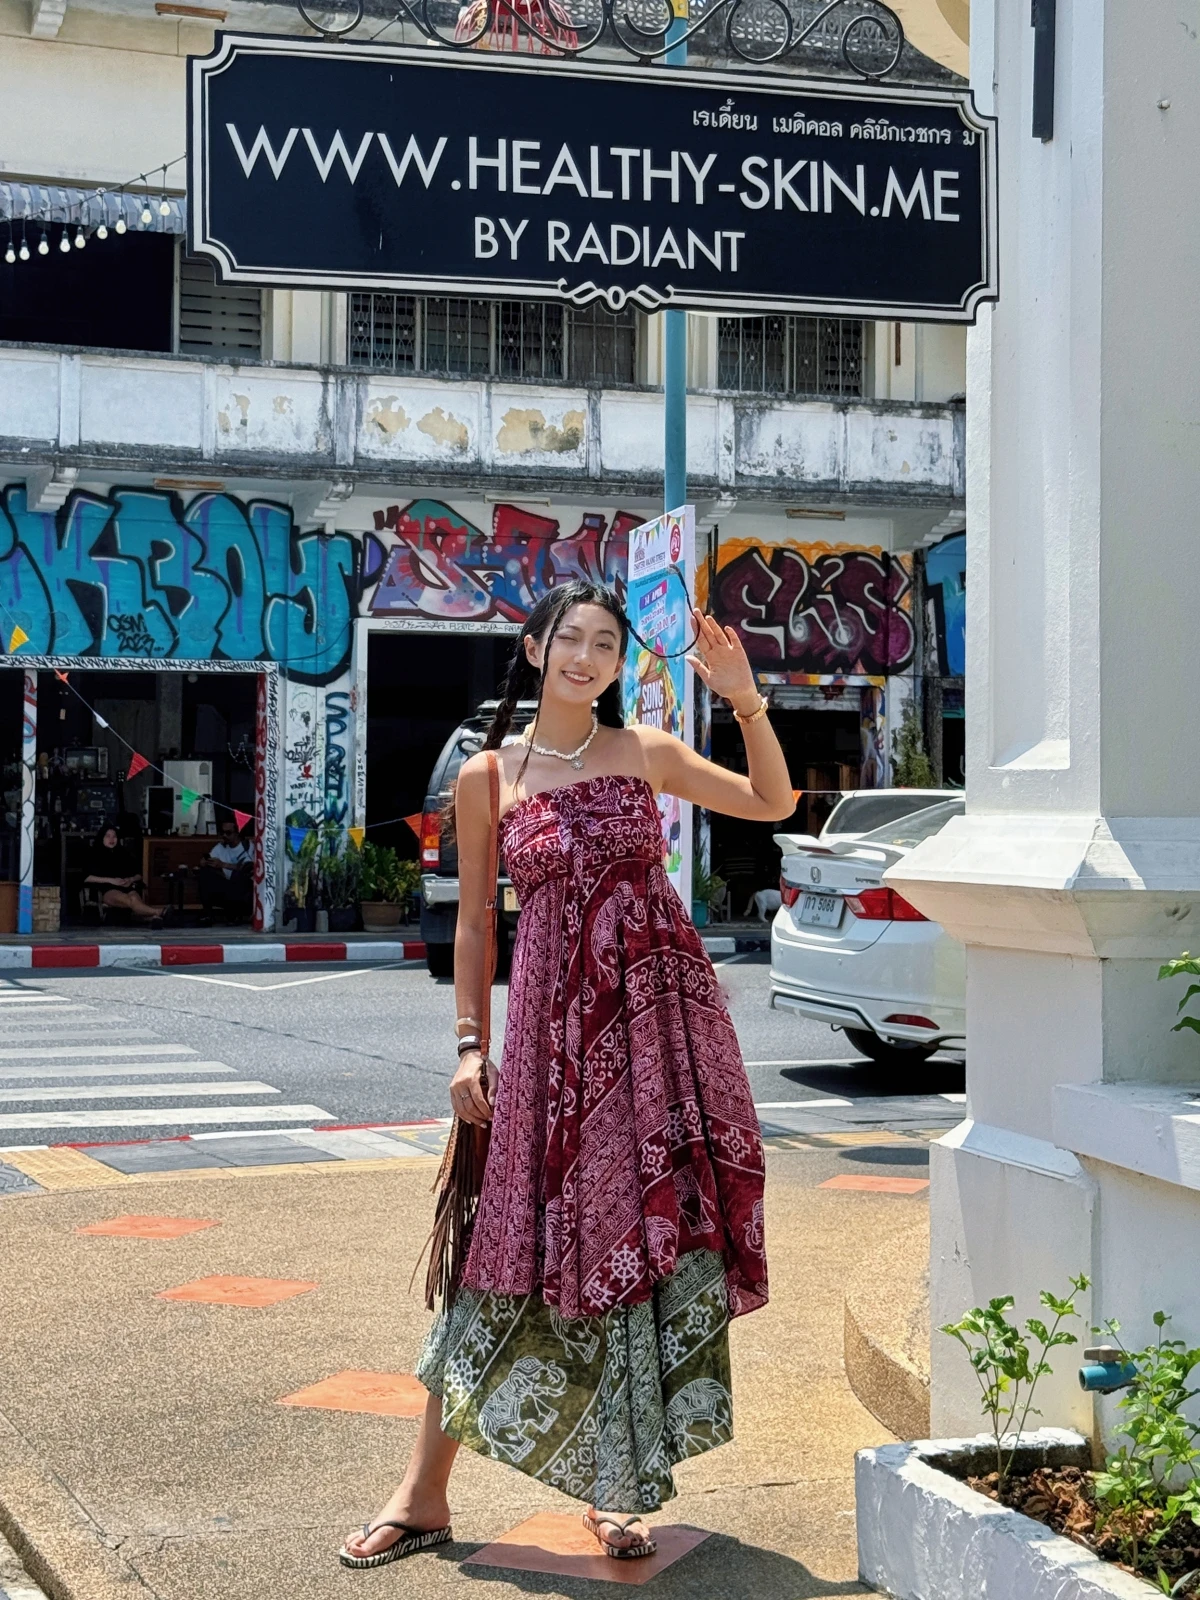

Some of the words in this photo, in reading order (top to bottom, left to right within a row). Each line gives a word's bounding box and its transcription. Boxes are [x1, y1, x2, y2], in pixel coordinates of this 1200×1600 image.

[772, 111, 843, 138] เมดิคอล
[225, 122, 961, 222] WWW.HEALTHY-SKIN.ME
[474, 216, 530, 261] BY
[547, 220, 747, 274] RADIANT
[642, 679, 664, 712] SONG
